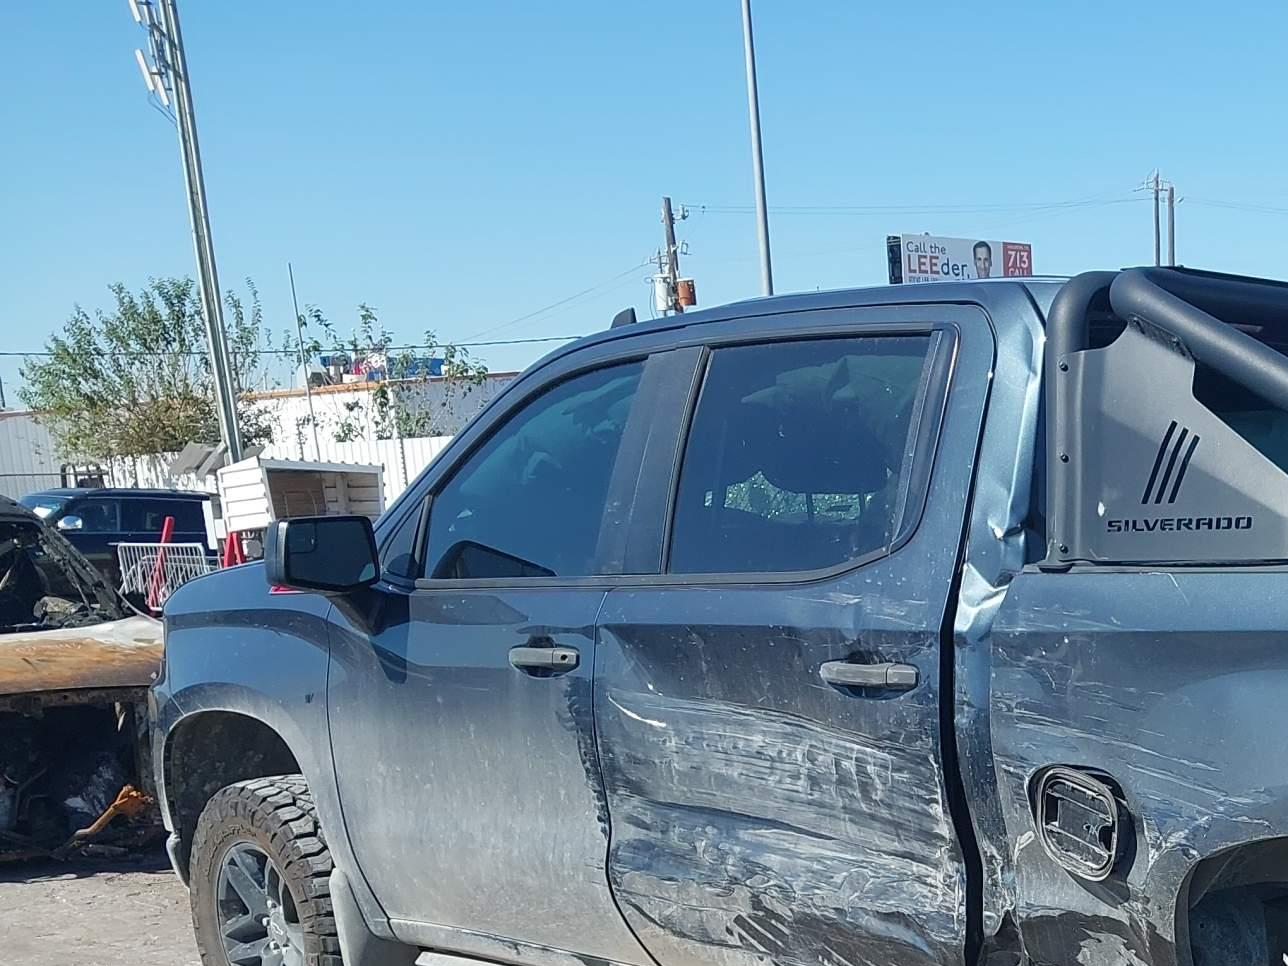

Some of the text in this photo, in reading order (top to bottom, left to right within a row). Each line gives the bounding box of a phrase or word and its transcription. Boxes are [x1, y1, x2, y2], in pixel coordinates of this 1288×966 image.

[906, 241, 946, 255] Call the
[1007, 250, 1029, 268] 713
[1107, 516, 1253, 533] SILVERADO
